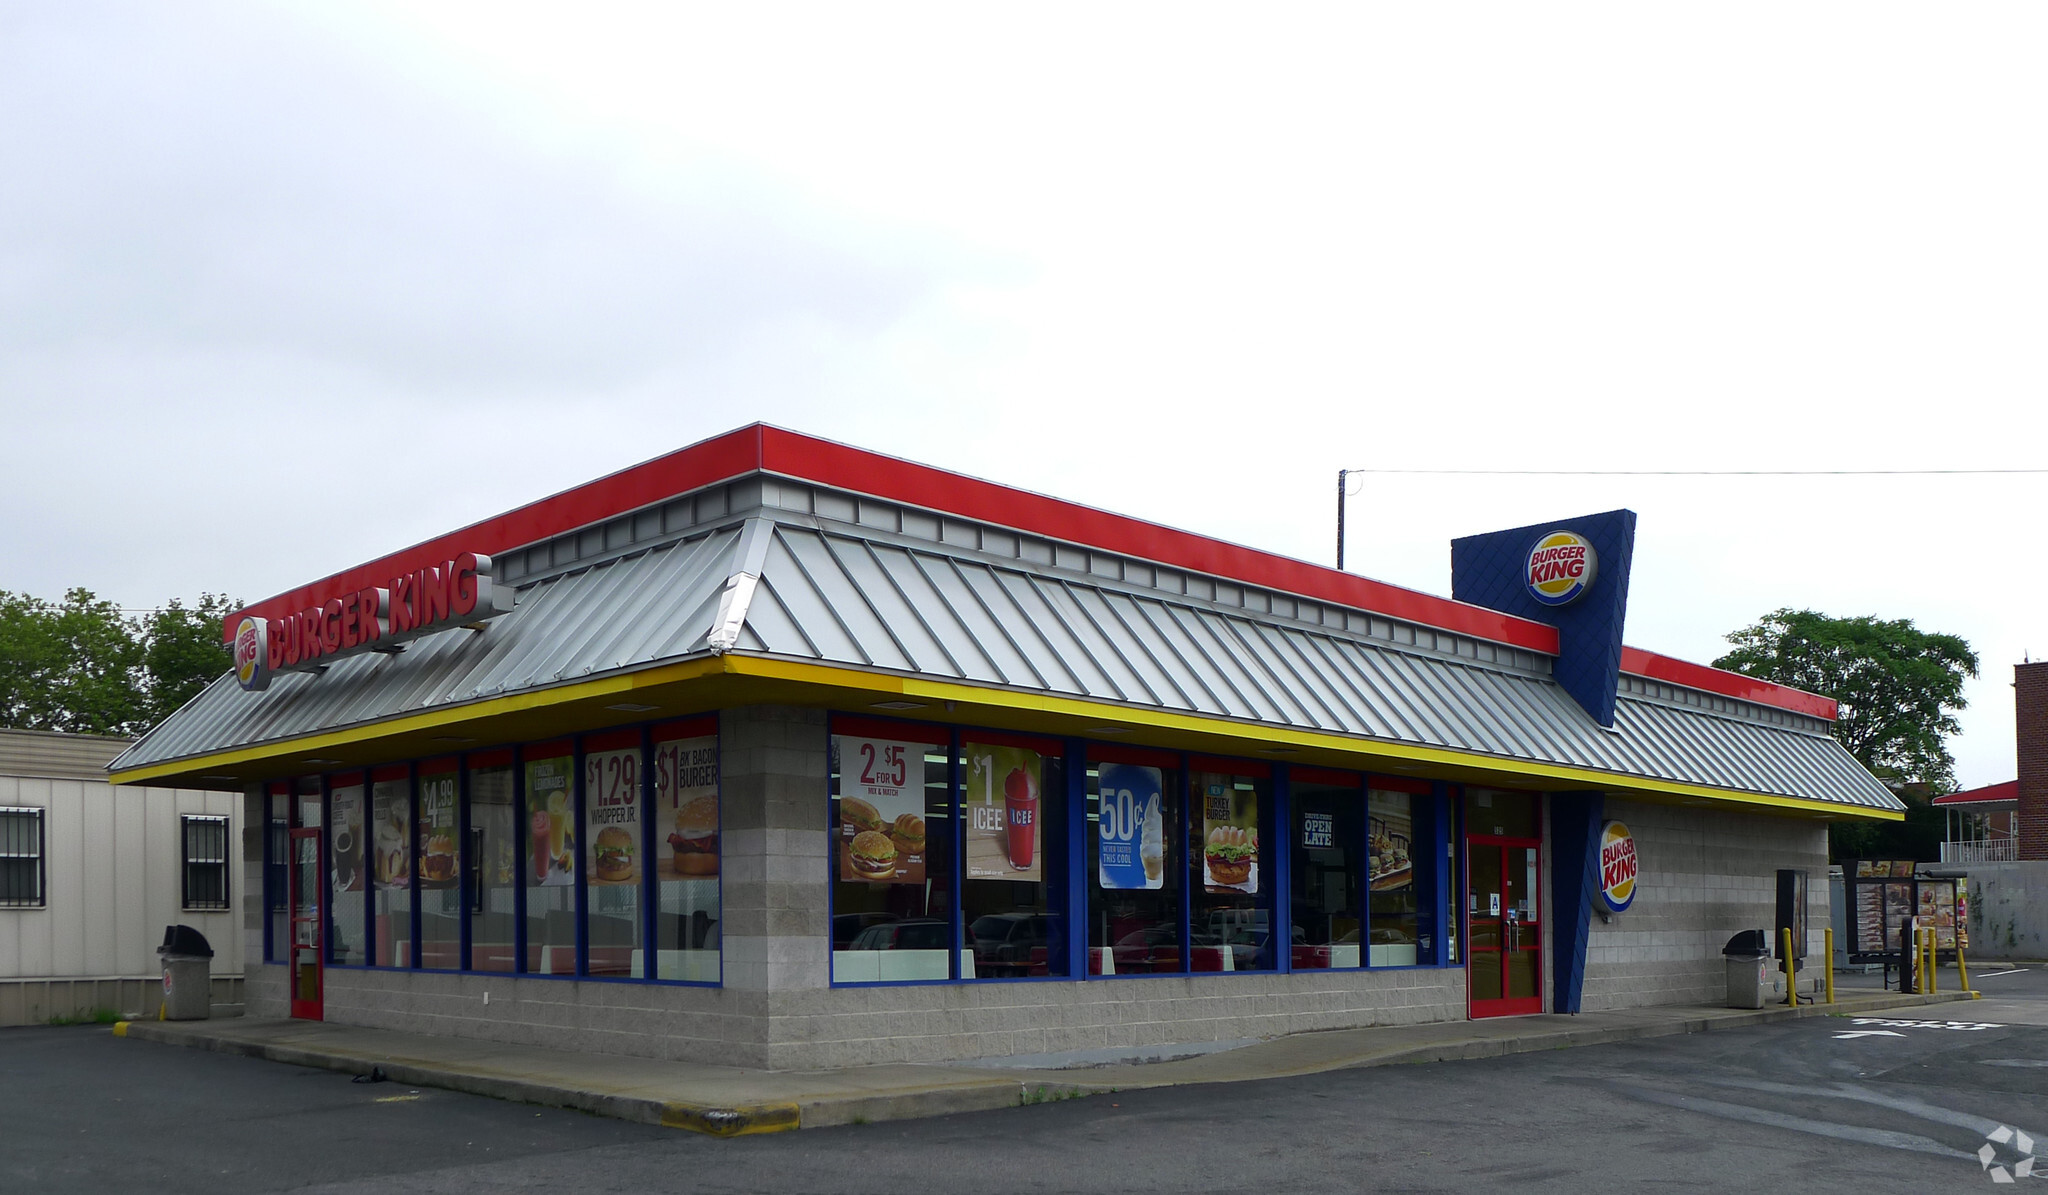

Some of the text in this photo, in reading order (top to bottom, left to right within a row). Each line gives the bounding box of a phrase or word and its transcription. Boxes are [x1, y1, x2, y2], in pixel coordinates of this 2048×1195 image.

[1531, 546, 1585, 566] BURGER
[1530, 559, 1585, 585] KING
[267, 552, 478, 671] BURGER KING
[680, 748, 717, 767] BK BACON
[861, 743, 906, 787] 2 FOR $5
[588, 754, 635, 807] $1.29
[658, 745, 679, 809] $1
[680, 765, 717, 788] BURGER
[973, 754, 993, 806] $1
[424, 779, 453, 828] $4.99
[883, 789, 899, 797] MATCH
[1206, 796, 1230, 810] TURKEY
[591, 807, 626, 825] WHOPPER
[973, 807, 1003, 831] ICEE
[1010, 808, 1033, 825] ICEE
[1206, 809, 1231, 821] BURGER
[1304, 819, 1333, 833] OPEN
[1304, 831, 1332, 846] LATE
[1103, 853, 1132, 864] THIS COOL
[1603, 838, 1635, 867] BURGER
[1603, 853, 1636, 891] KING
[1492, 896, 1499, 910] A
